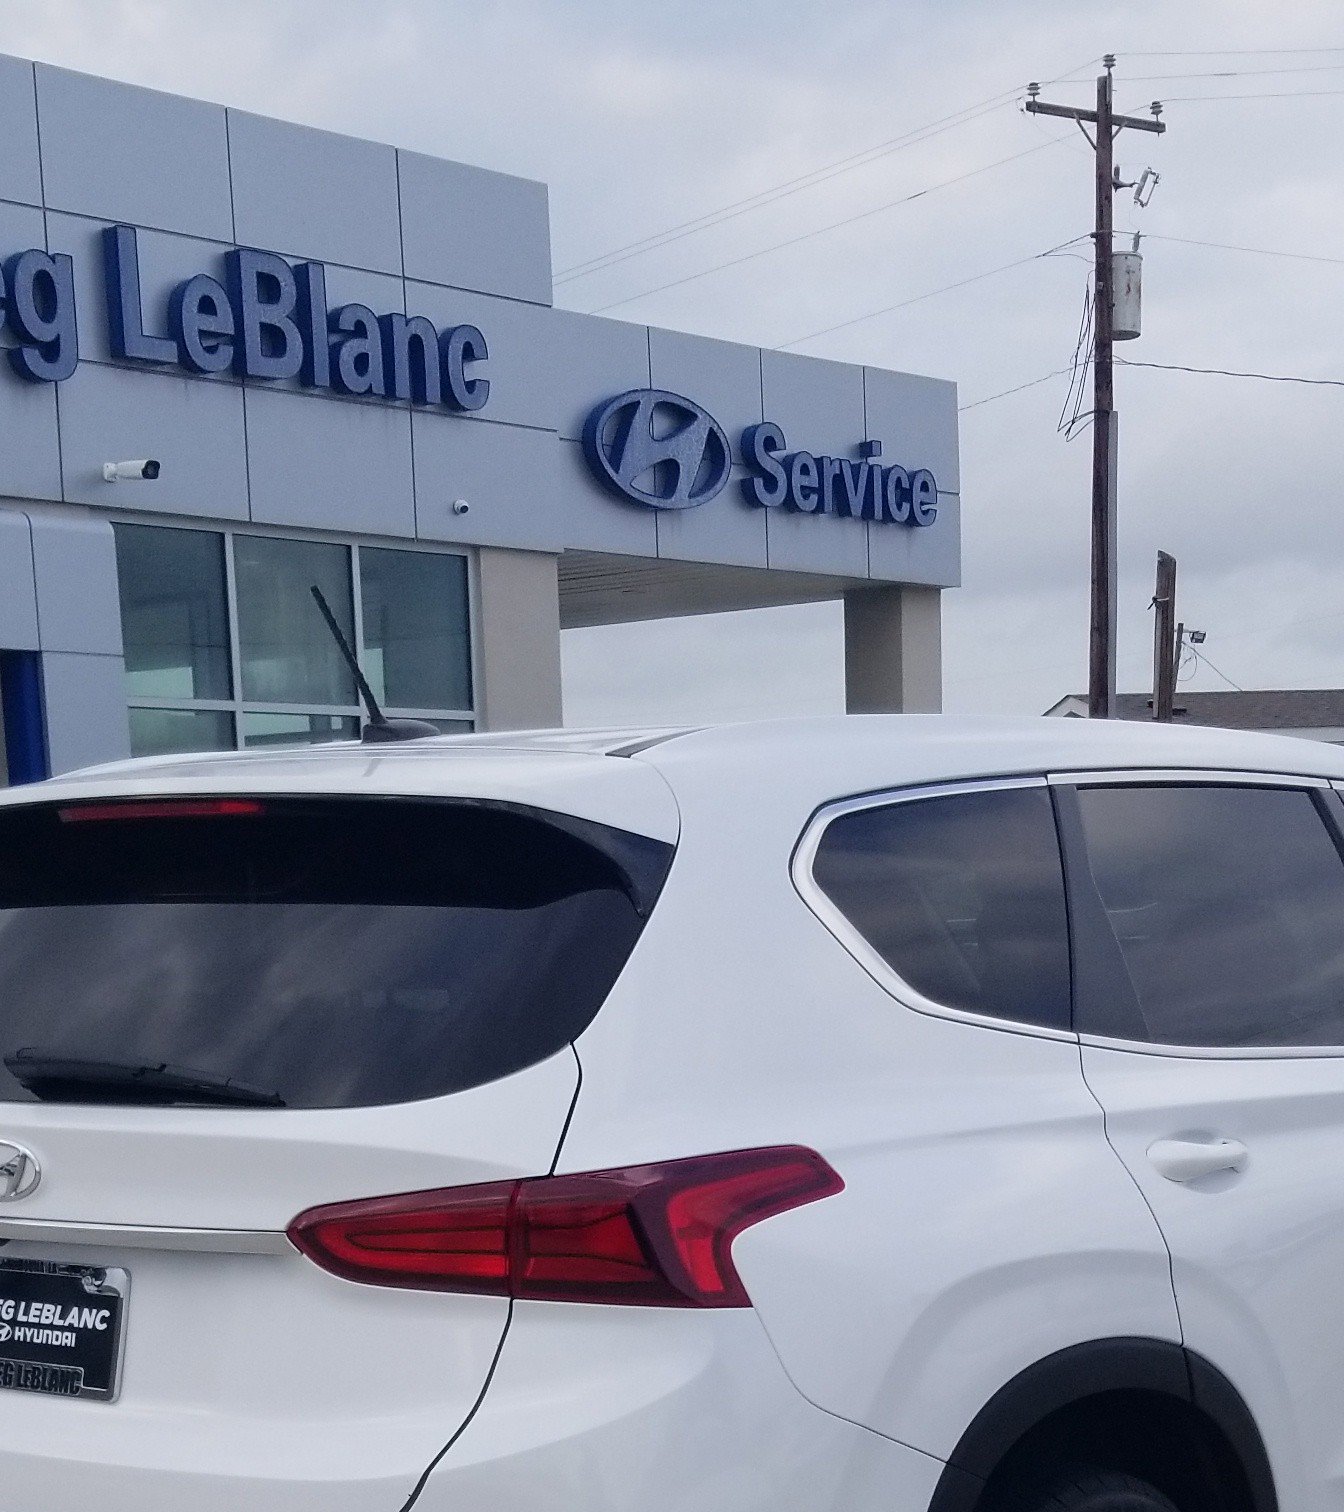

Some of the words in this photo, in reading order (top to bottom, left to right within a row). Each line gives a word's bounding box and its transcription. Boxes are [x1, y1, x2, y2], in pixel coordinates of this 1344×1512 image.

[102, 225, 490, 411] LeBlanc
[741, 422, 938, 527] Service
[14, 1326, 77, 1348] HYUNDAI
[17, 1301, 110, 1331] LEBLANC
